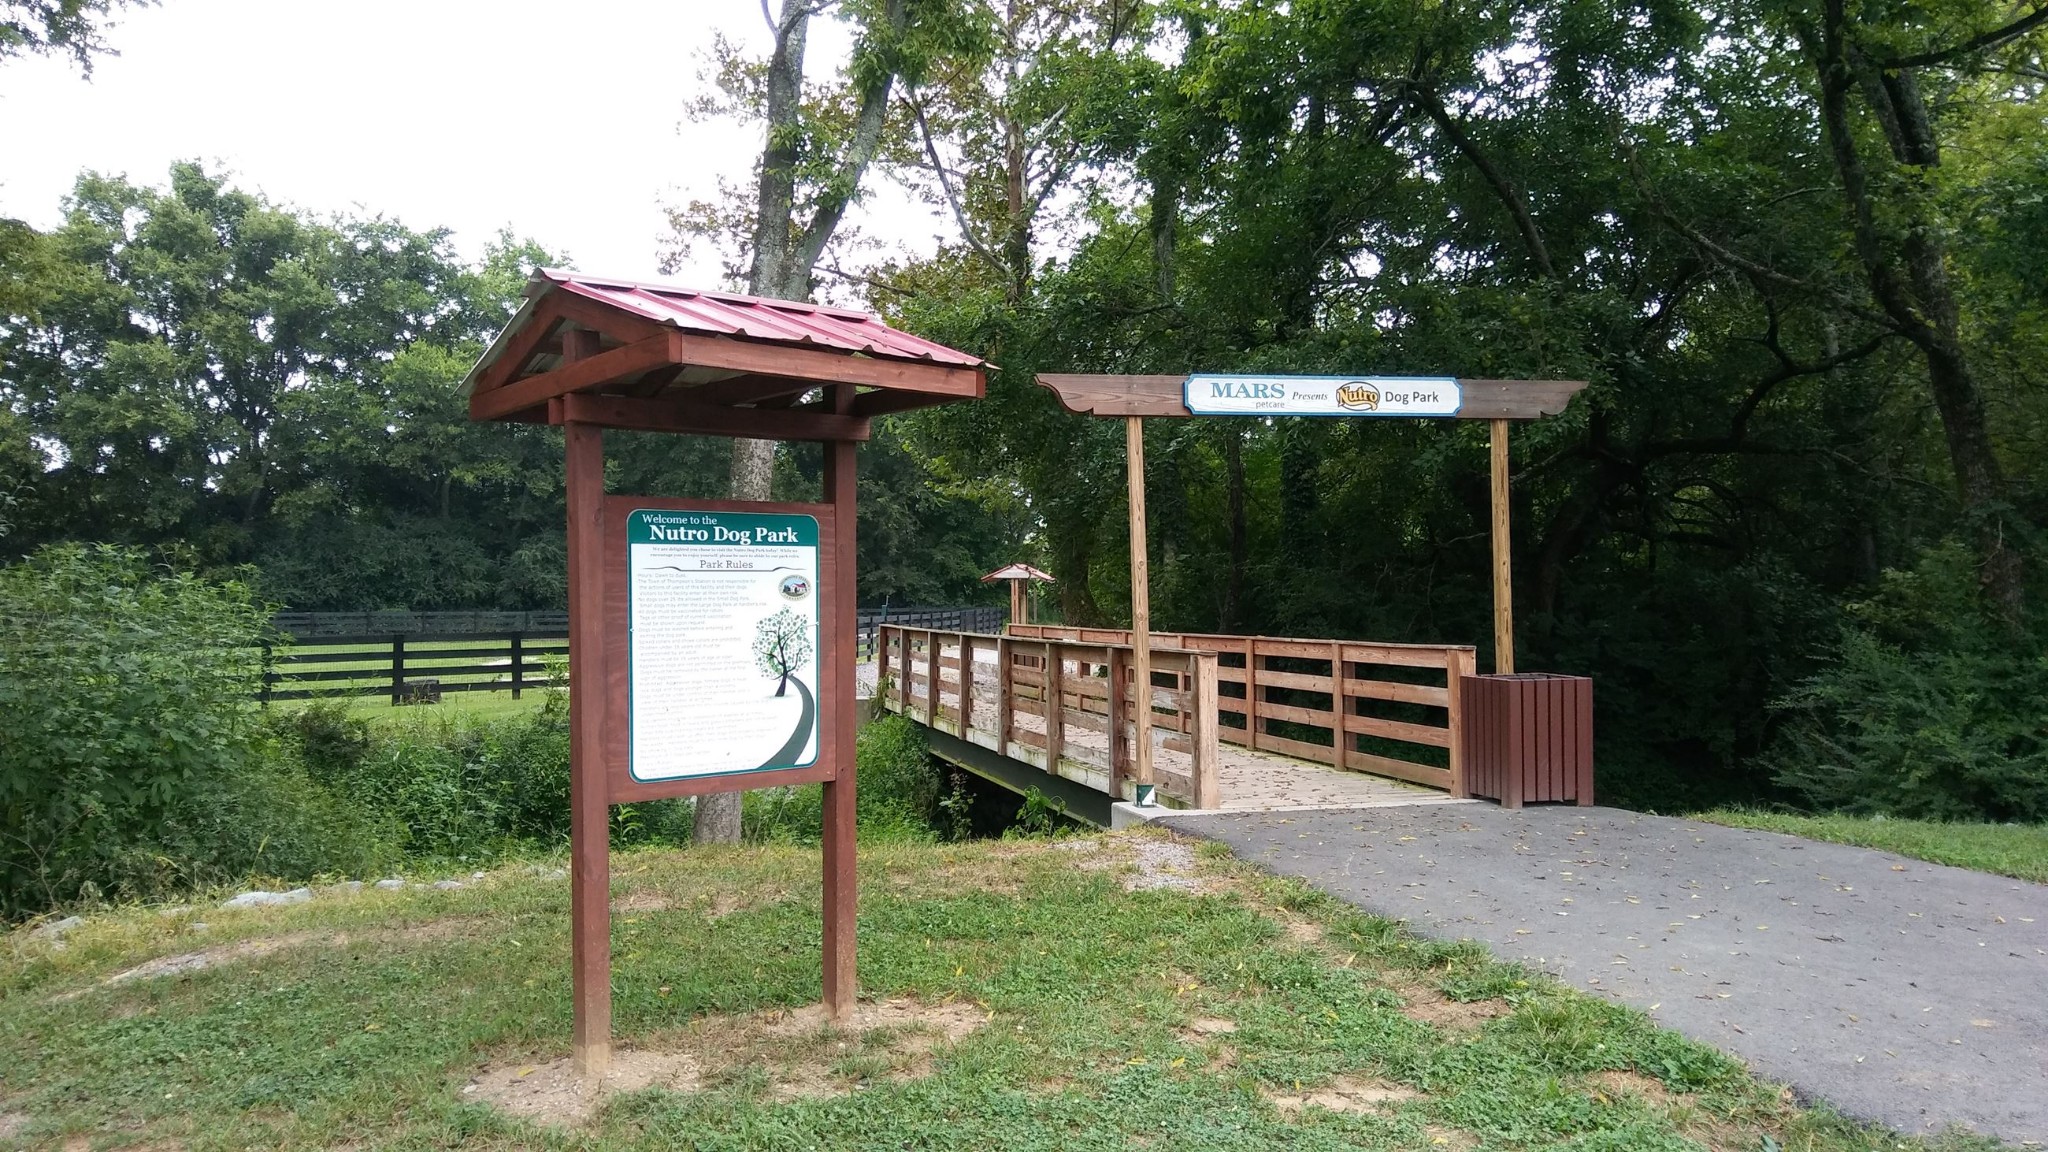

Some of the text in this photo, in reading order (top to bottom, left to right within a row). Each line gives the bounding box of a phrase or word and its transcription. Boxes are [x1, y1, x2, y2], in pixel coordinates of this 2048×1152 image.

[1210, 382, 1439, 407] MARS Presents Nutro Dog Park
[1255, 400, 1286, 410] petcare
[642, 514, 718, 525] Welcome to the
[649, 524, 799, 545] Nutro Dog Park
[700, 560, 754, 569] Park Rules
